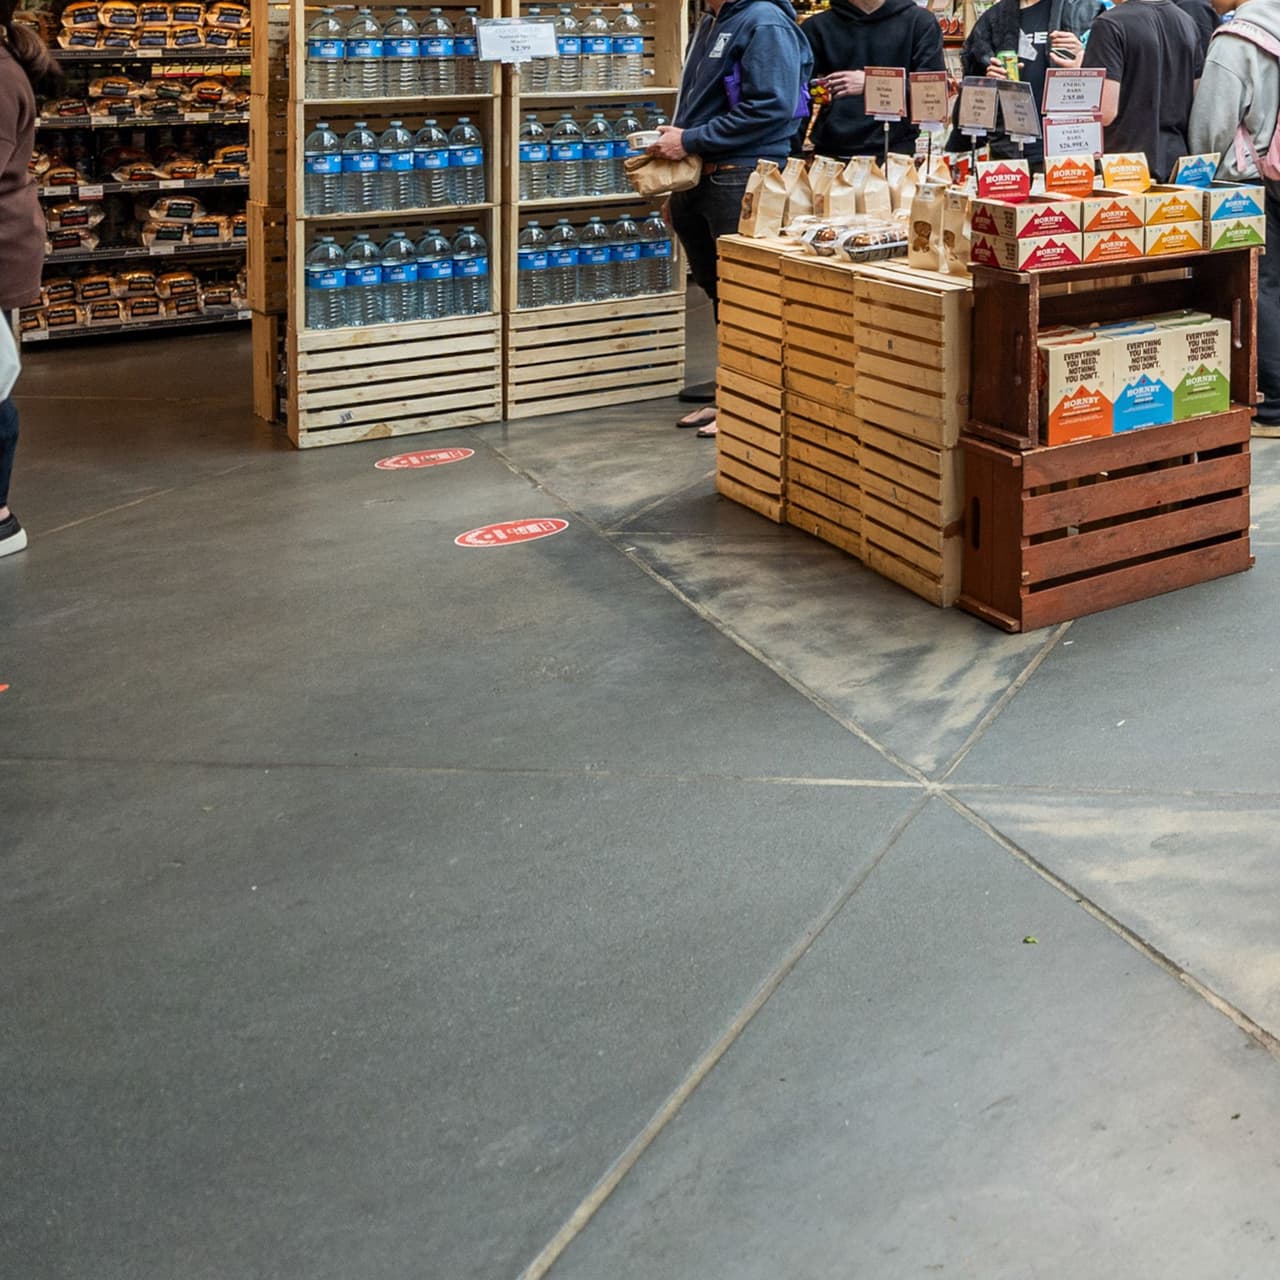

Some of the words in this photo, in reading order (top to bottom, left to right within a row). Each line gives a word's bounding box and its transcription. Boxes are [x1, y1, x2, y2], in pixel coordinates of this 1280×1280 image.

[986, 173, 1022, 184] HORNBY
[1185, 329, 1219, 342] EVERYTHING
[1126, 338, 1162, 352] EVERYTHING
[1188, 339, 1200, 348] YOU
[1201, 337, 1217, 346] NEED.
[1064, 349, 1100, 362] EVERYTHING
[1129, 349, 1142, 358] YOU
[1143, 347, 1159, 356] NEED.
[1190, 345, 1215, 355] NOTHING
[1131, 355, 1158, 365] NOTHING
[1187, 354, 1199, 363] YOU
[1200, 351, 1219, 360] DON'T.
[1067, 359, 1080, 369] YOU
[1081, 358, 1098, 368] NEED.
[1128, 364, 1141, 373] YOU
[1142, 361, 1161, 370] DON'T.
[1068, 366, 1096, 376] NOTHING
[1065, 375, 1078, 384] YOU
[1080, 372, 1100, 381] DON'T.
[1185, 374, 1218, 387] HORNBY
[1127, 384, 1162, 397] HORNBY
[1063, 395, 1101, 410] HORNBY
